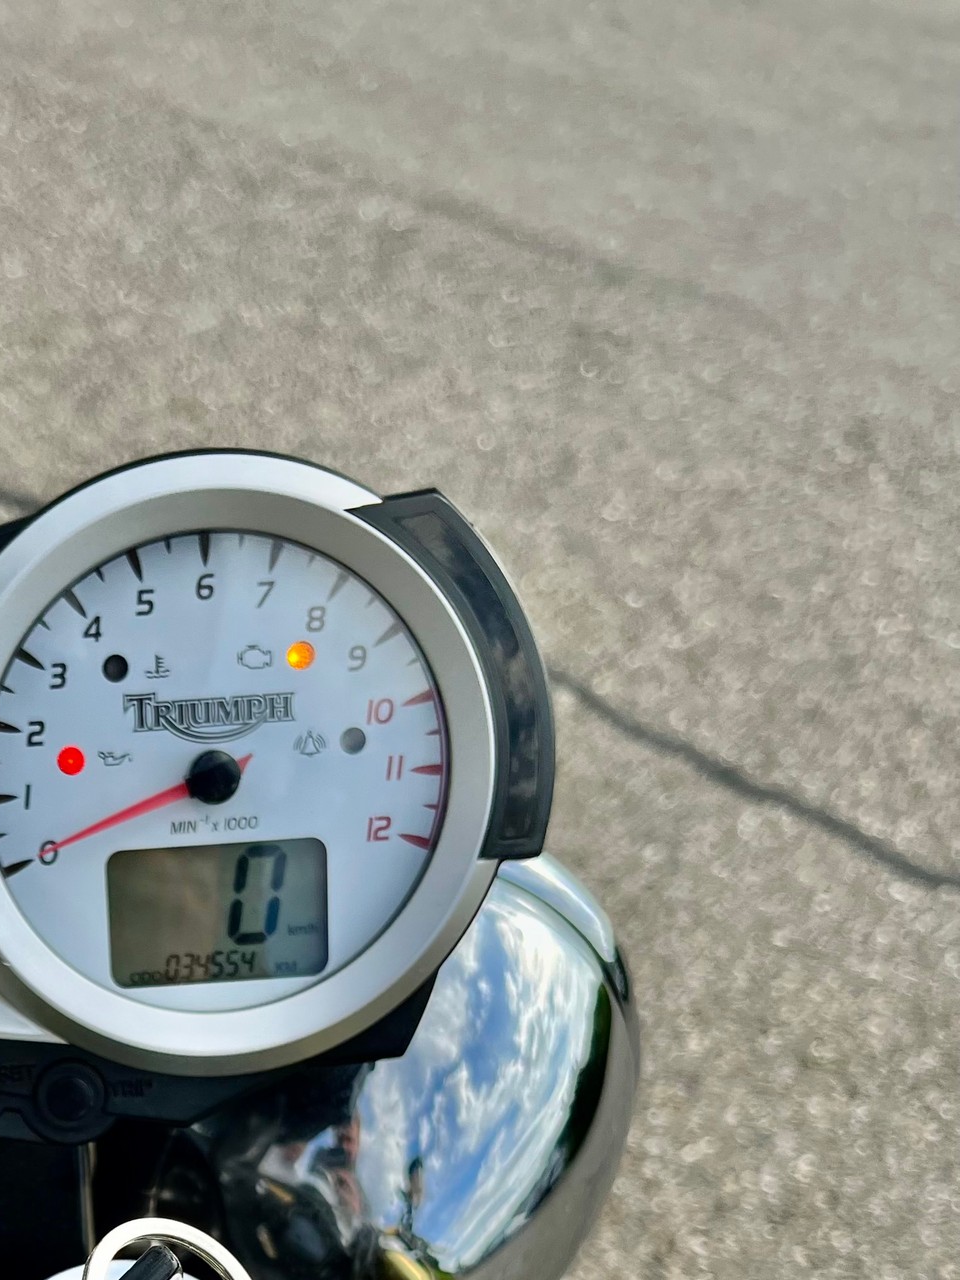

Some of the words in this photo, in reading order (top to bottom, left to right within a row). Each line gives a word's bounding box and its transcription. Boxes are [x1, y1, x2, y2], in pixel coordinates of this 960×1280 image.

[195, 573, 215, 600] 6
[256, 581, 275, 608] 7
[136, 590, 155, 616] 5
[83, 616, 102, 641] 4
[305, 606, 326, 632] 8
[347, 645, 367, 671] 9
[50, 663, 67, 689] 3
[122, 692, 296, 744] TRIUMPH
[366, 700, 394, 725] 10
[26, 721, 46, 747] 2
[386, 755, 404, 780] 11
[23, 784, 32, 810] 1
[224, 816, 258, 832] 1000
[366, 816, 391, 842] 12
[40, 841, 59, 866] 0
[227, 844, 287, 946] 0
[164, 951, 256, 983] 034554
